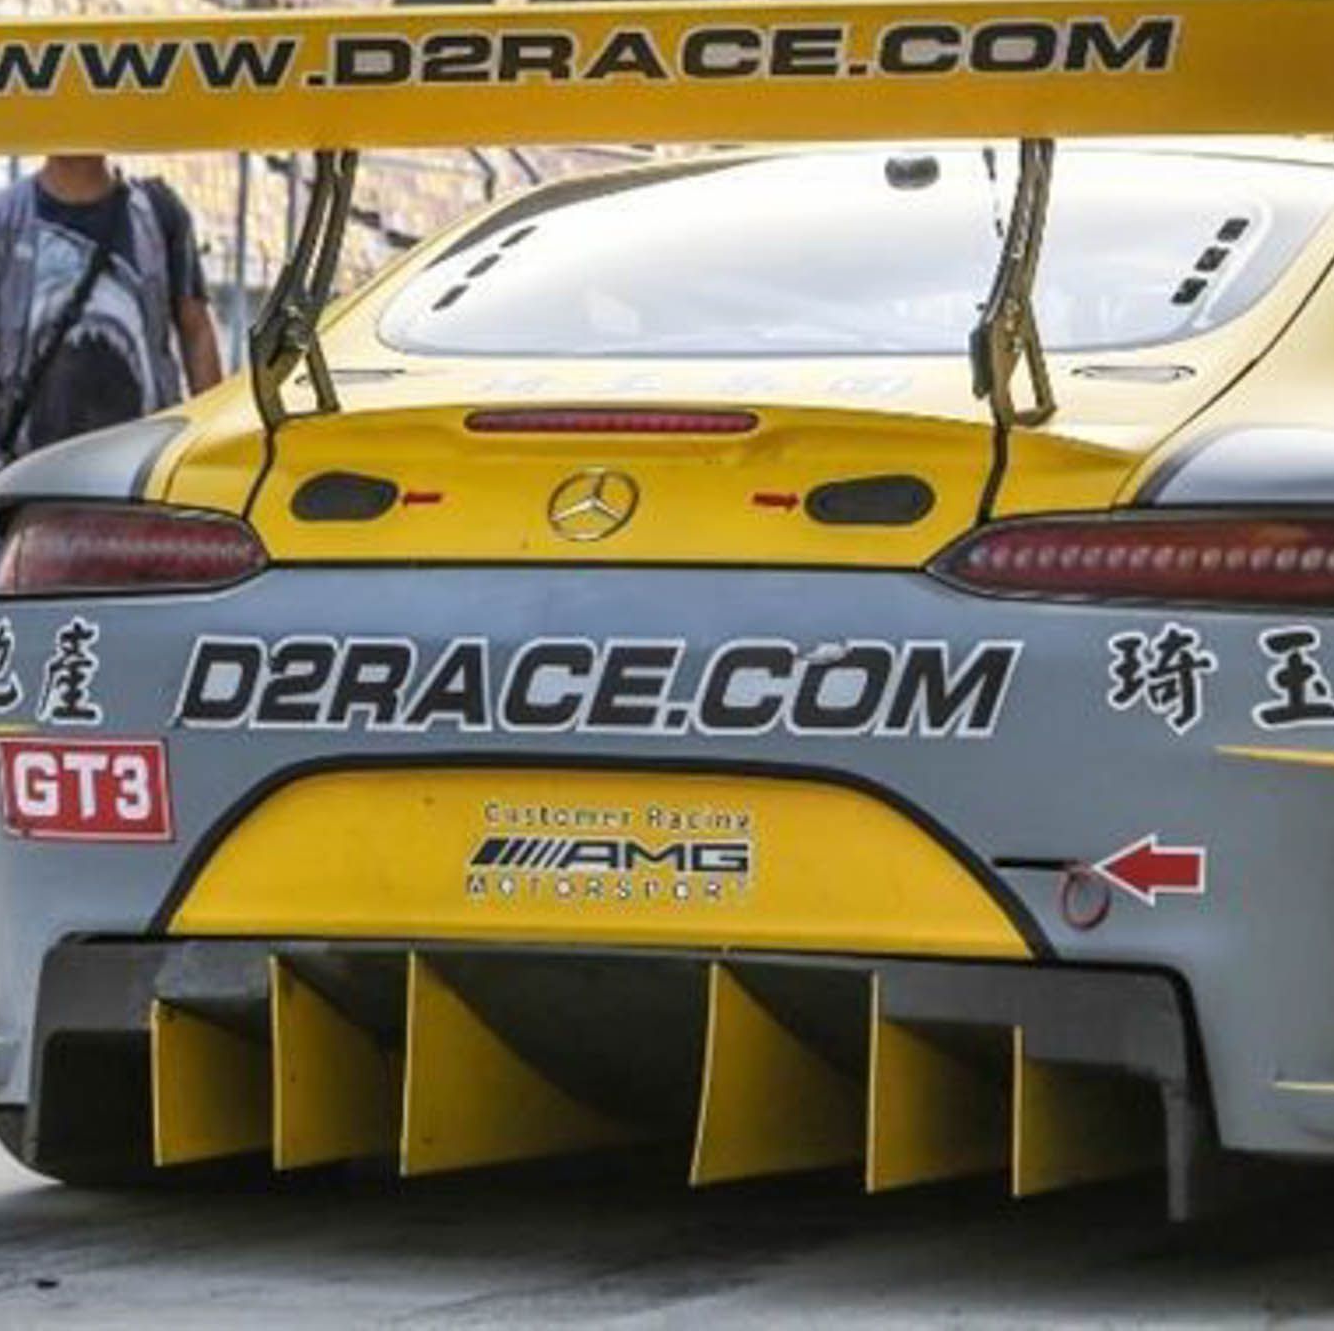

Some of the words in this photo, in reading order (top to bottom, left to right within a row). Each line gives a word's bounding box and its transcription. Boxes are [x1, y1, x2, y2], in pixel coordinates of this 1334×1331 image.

[176, 636, 1021, 734] D2RACE.COM
[12, 751, 153, 821] GT3
[484, 800, 632, 829] Customer
[465, 872, 749, 902] MOTORSPORT
